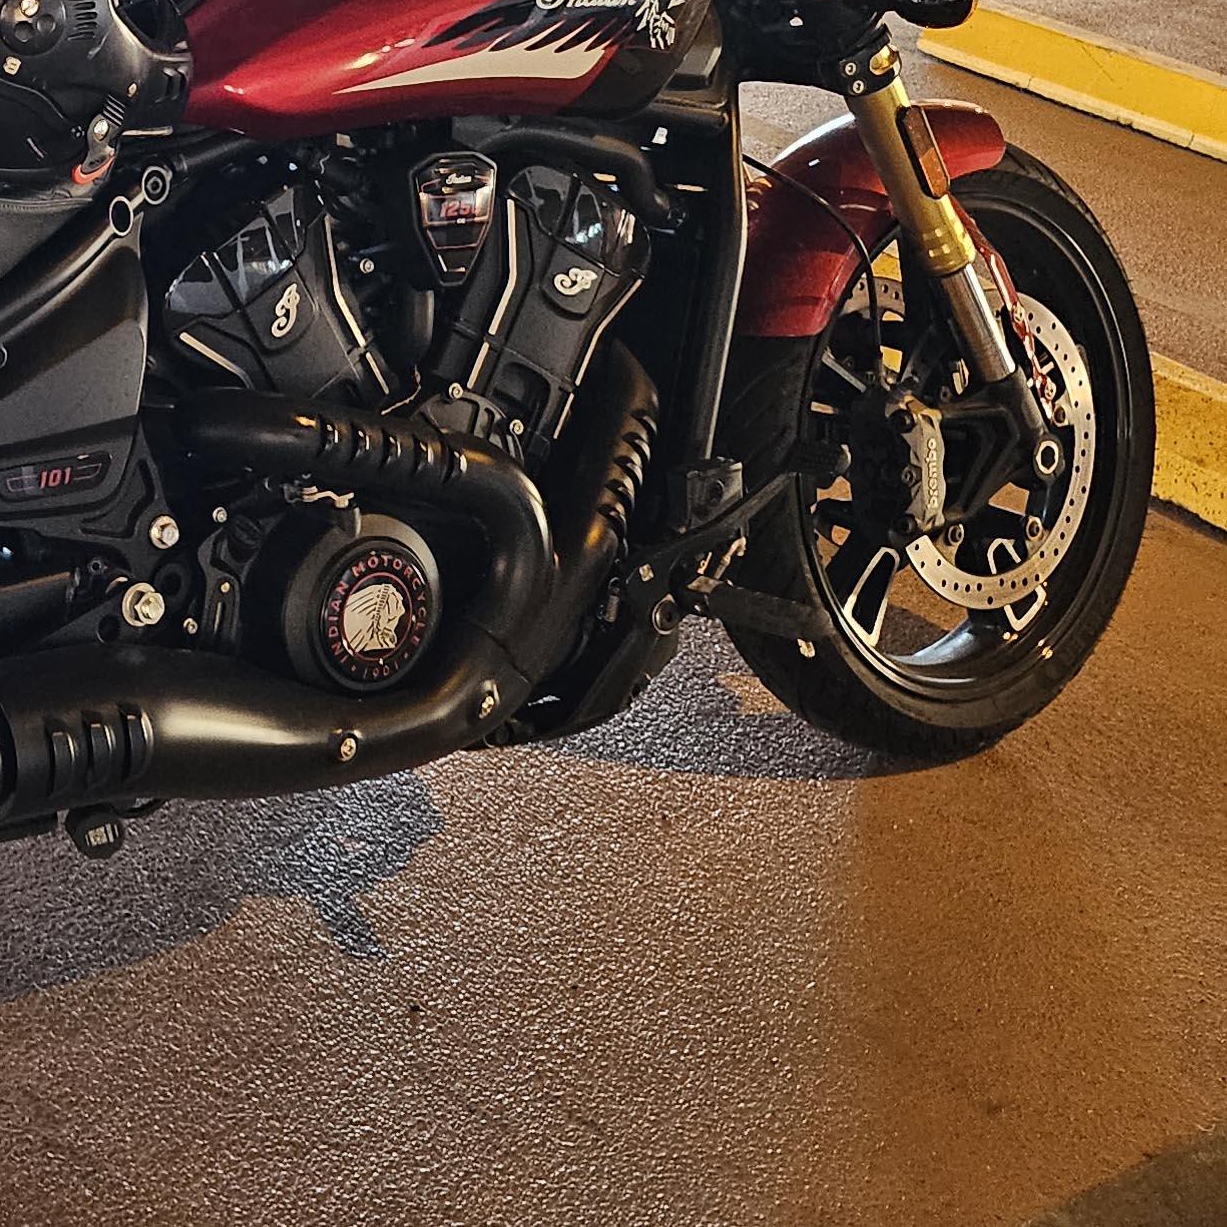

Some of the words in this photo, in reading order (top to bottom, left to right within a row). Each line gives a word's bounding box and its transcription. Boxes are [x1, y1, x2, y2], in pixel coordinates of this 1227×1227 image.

[39, 467, 72, 489] 101
[925, 437, 939, 510] brembo
[327, 579, 350, 663] INDIAN
[351, 553, 428, 646] MOTORCYCLE
